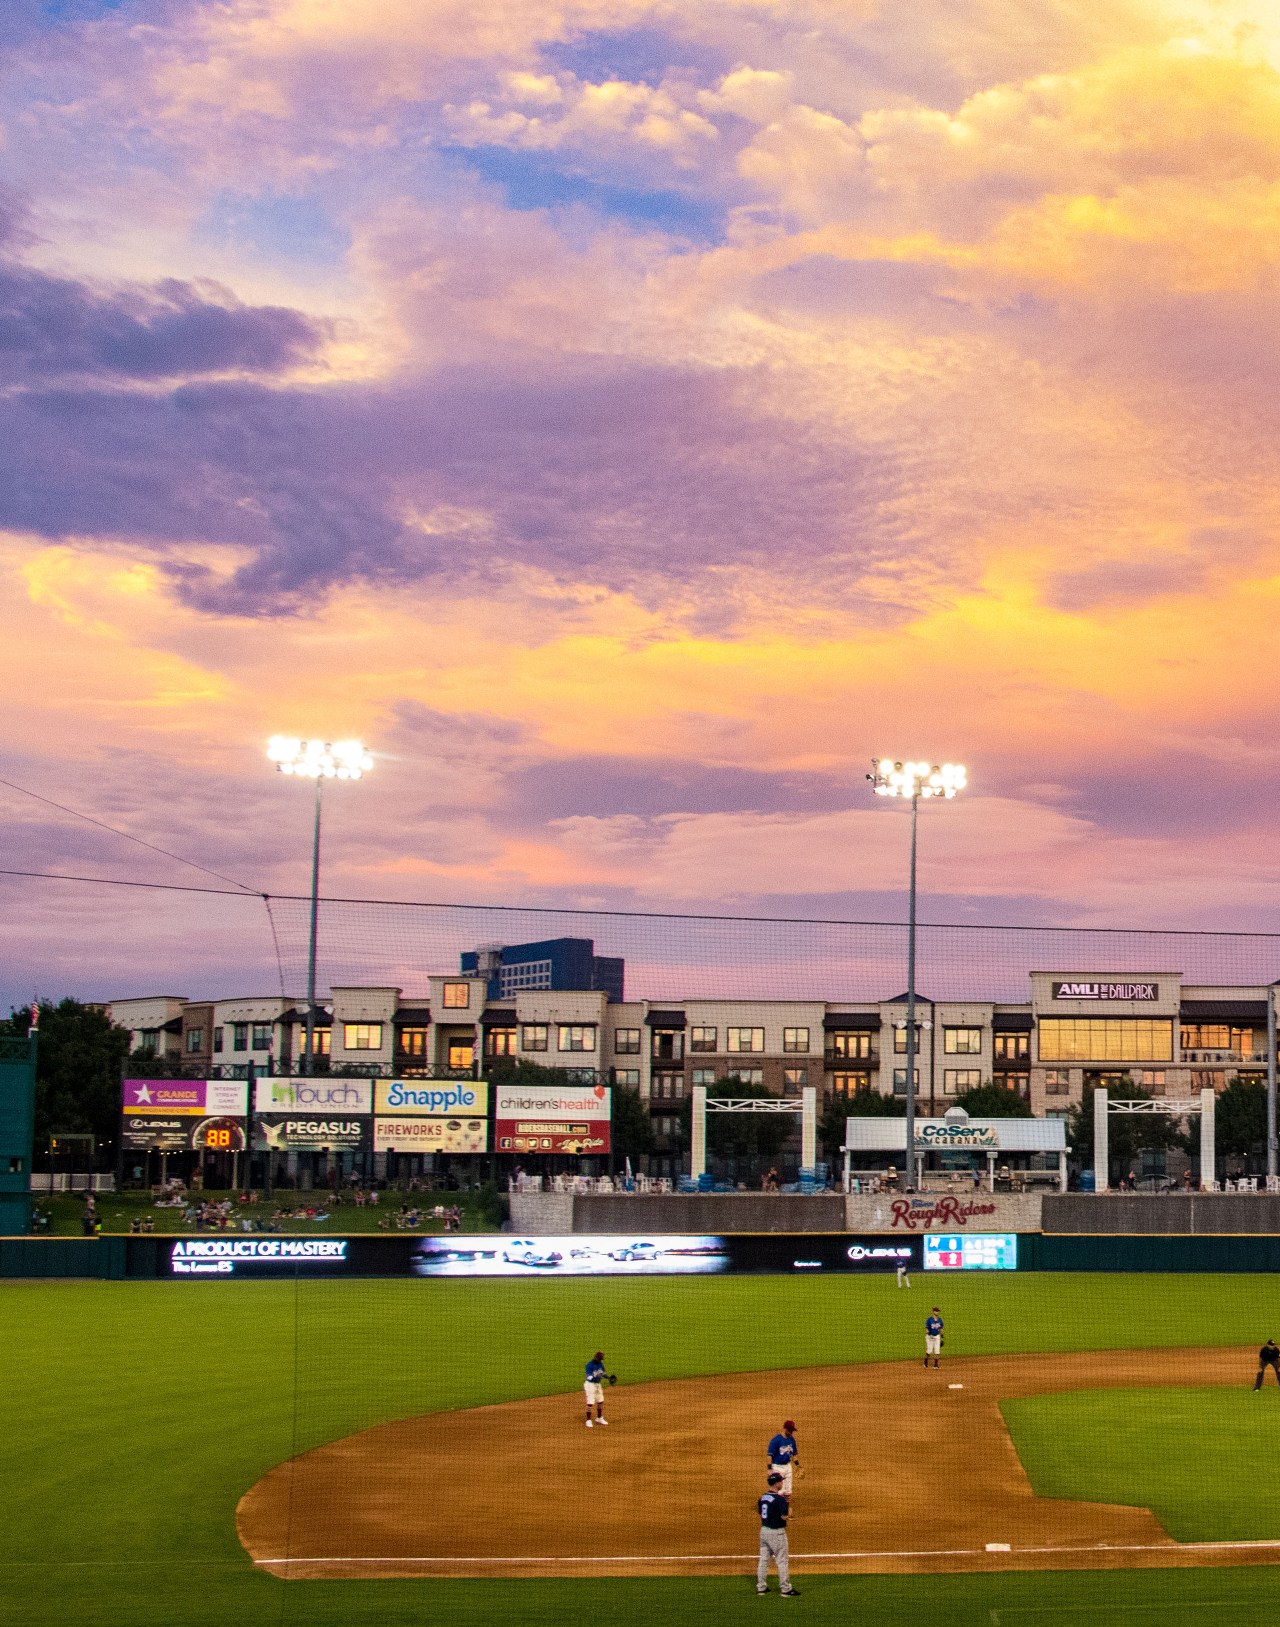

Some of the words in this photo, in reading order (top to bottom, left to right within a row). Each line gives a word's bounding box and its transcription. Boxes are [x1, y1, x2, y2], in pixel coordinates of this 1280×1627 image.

[1059, 984, 1098, 994] AMLI
[1109, 984, 1154, 999] BALLPARK
[157, 1090, 197, 1099] GRANDE
[388, 1083, 475, 1112] Snapple
[286, 1121, 361, 1134] PEGASUS
[377, 1124, 442, 1136] FIREWORKS
[922, 1125, 989, 1136] CoServ
[207, 1129, 230, 1146] 88
[172, 1241, 185, 1255] A
[186, 1241, 257, 1255] PRODUCT
[258, 1241, 280, 1255] OF
[281, 1241, 346, 1255] MASTERY
